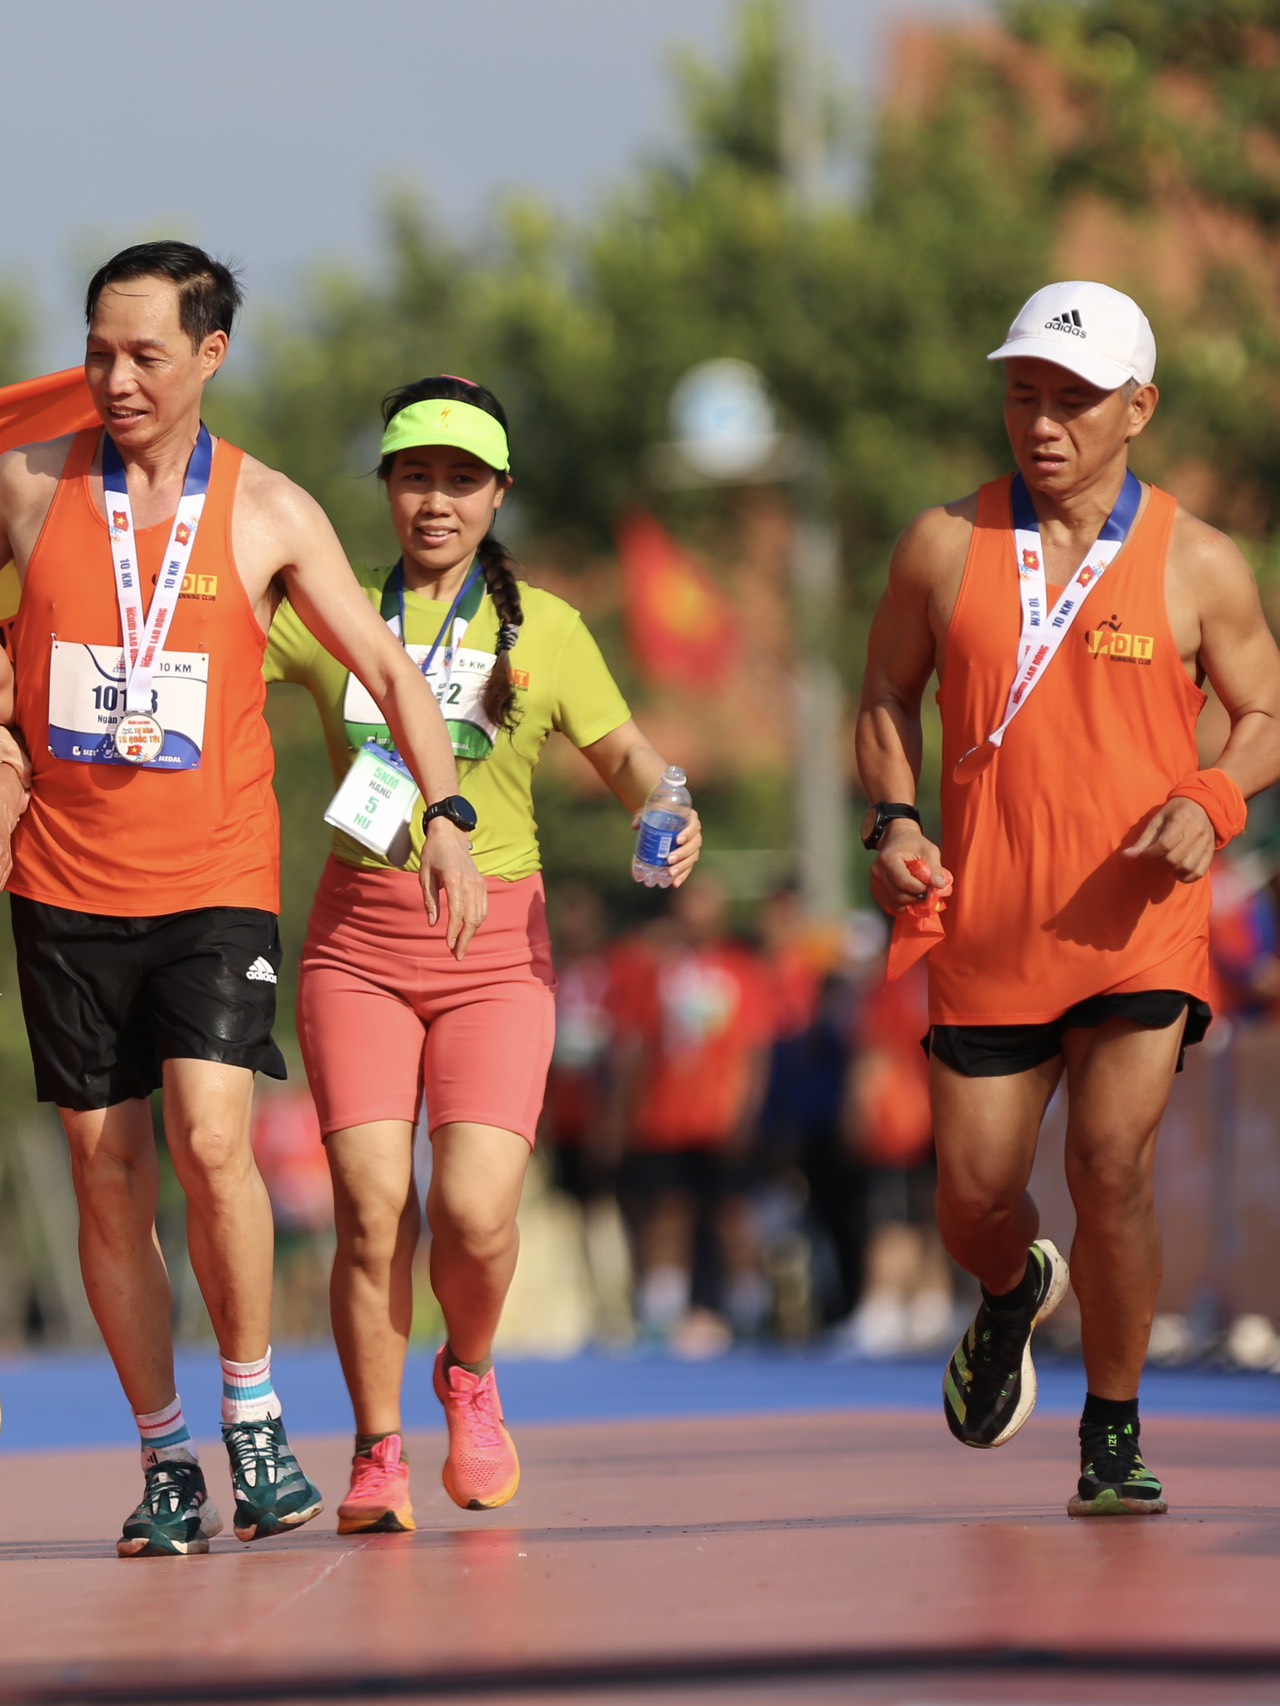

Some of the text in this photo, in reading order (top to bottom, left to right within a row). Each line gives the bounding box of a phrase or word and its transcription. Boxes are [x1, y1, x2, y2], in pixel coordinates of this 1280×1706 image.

[1044, 320, 1087, 339] adidas
[119, 558, 133, 589] 10 KM
[163, 560, 181, 590] 10 KM
[1028, 597, 1041, 627] 10 KM
[1051, 599, 1076, 629] 10 KM
[159, 662, 192, 673] 10 KM
[459, 659, 486, 670] 5 KM
[1110, 656, 1152, 666] RUNNING CLUB
[158, 755, 182, 763] MEDAL
[374, 767, 400, 789] 5KM
[365, 796, 380, 814] 5
